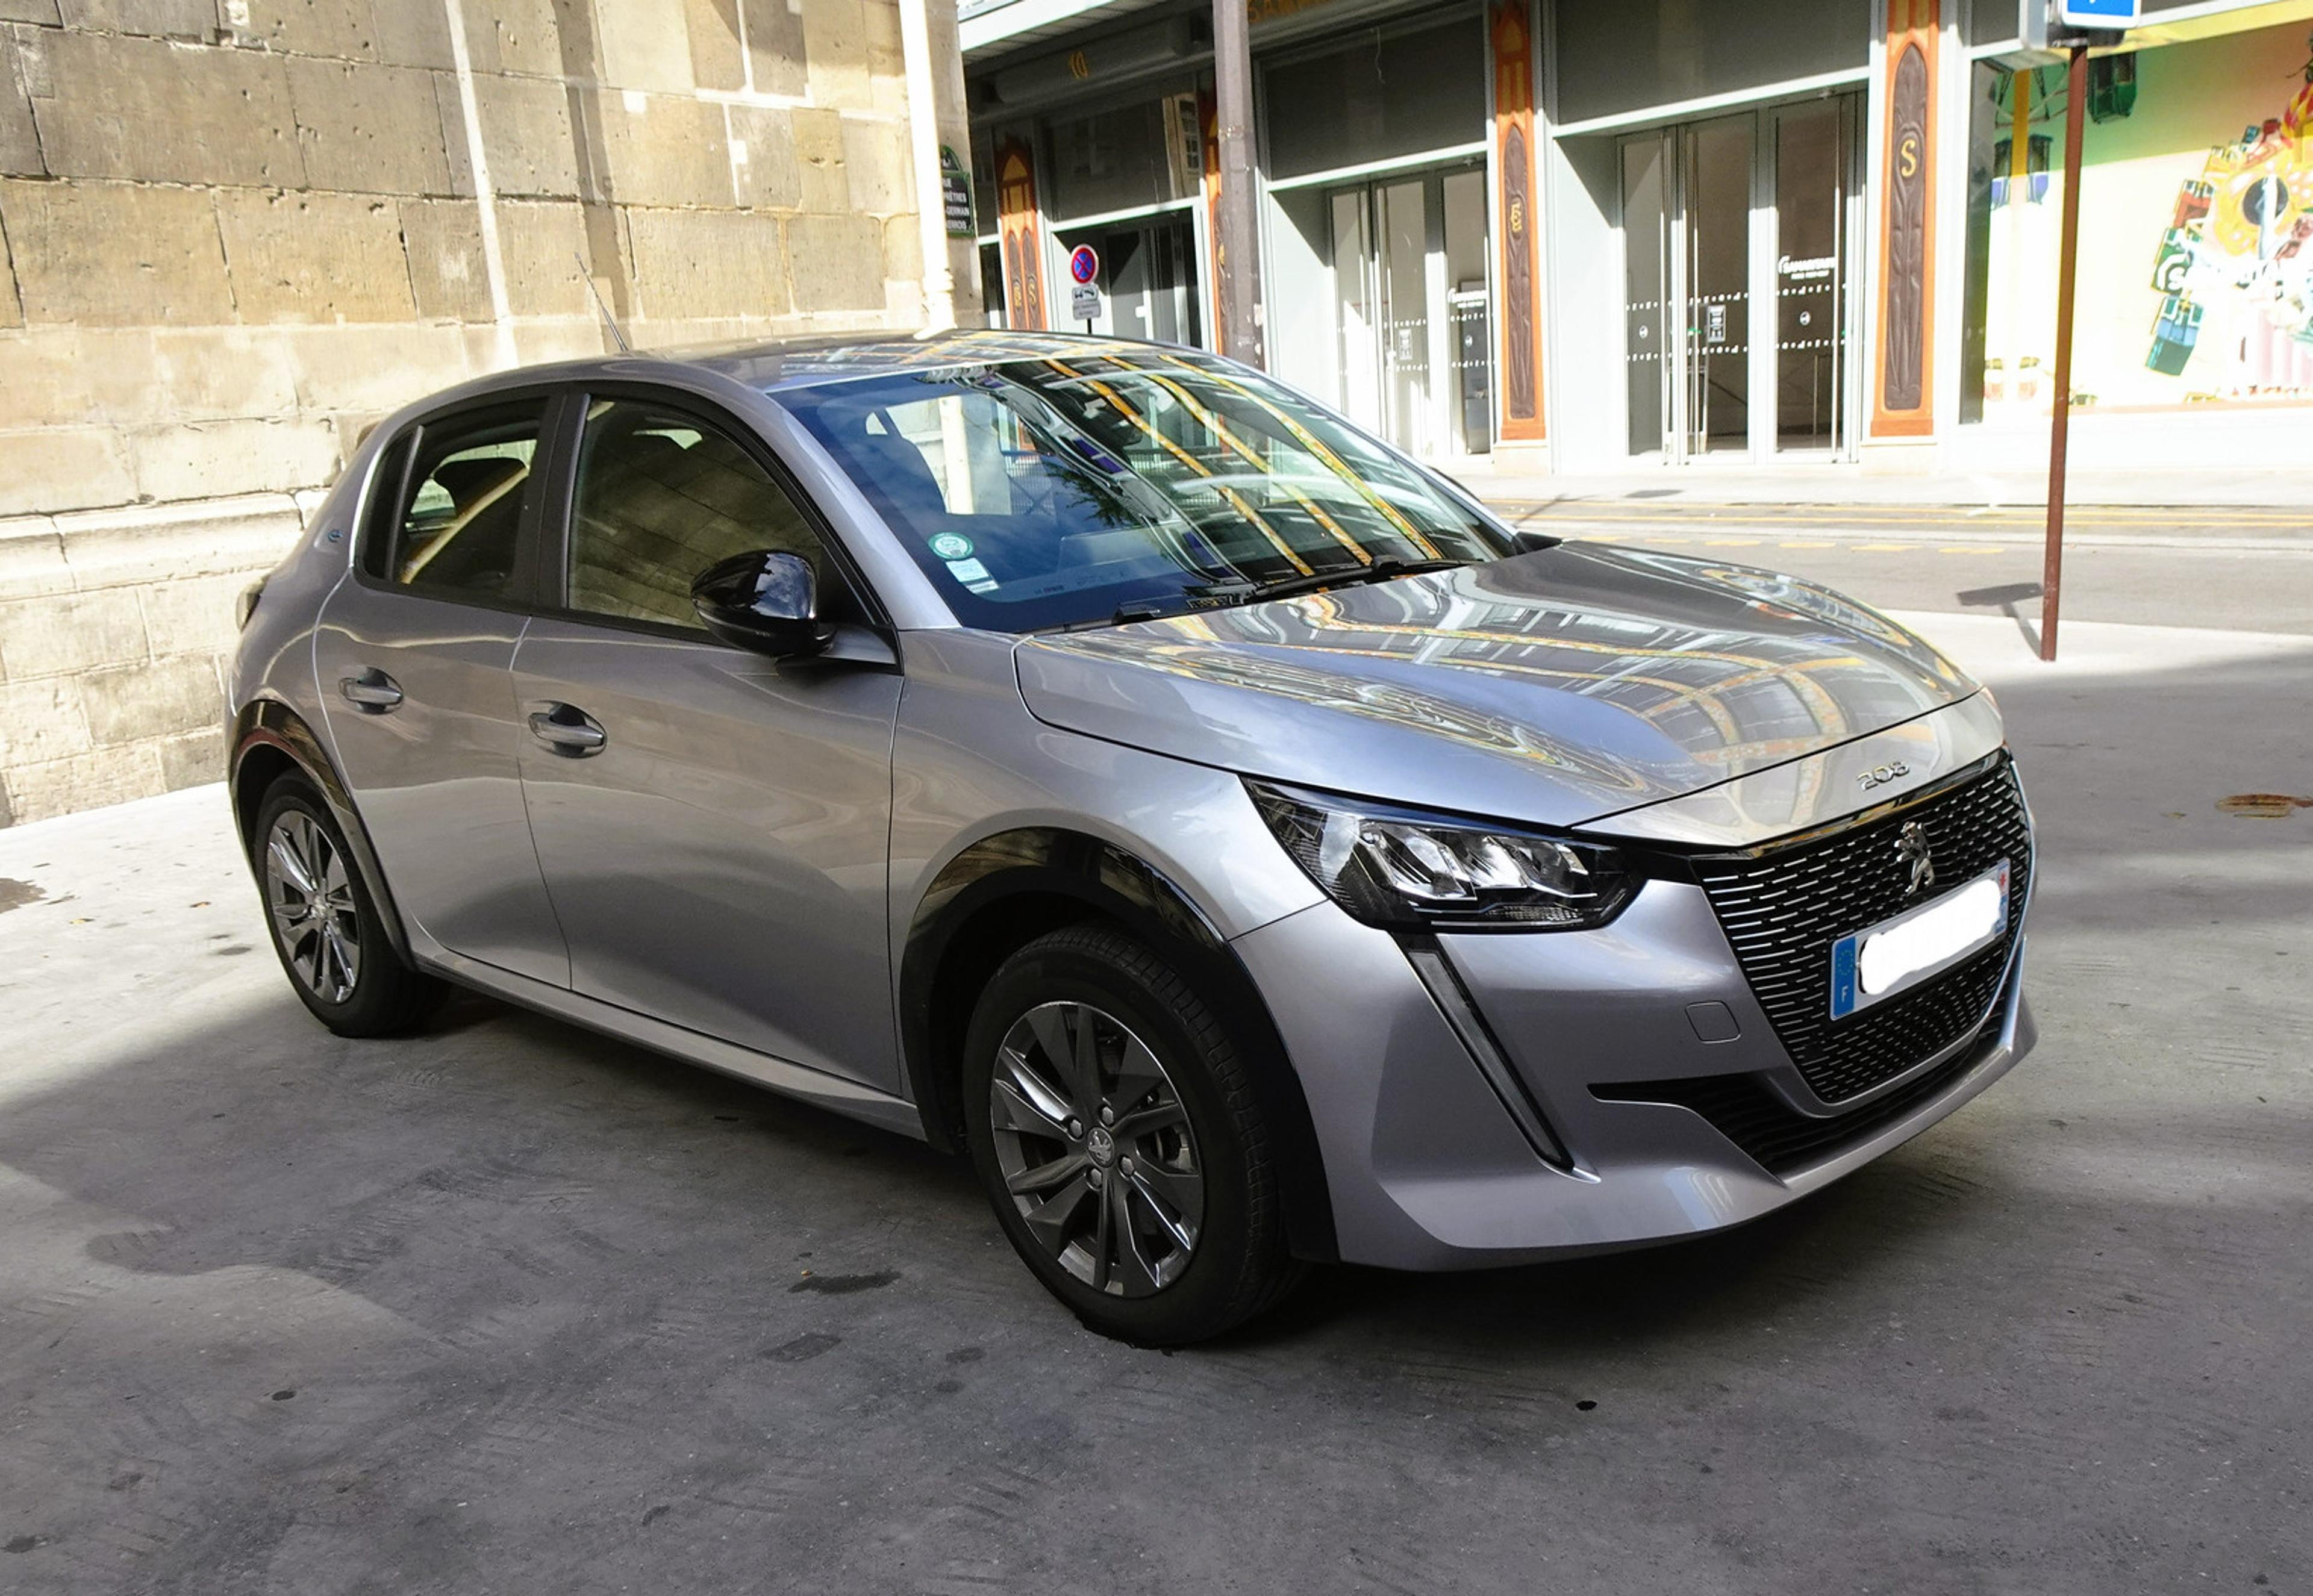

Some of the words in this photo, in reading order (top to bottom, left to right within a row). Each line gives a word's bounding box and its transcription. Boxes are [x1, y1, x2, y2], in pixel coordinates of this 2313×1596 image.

[1901, 139, 1916, 176] S
[1856, 761, 1910, 791] 208
[1841, 985, 1849, 1003] F
